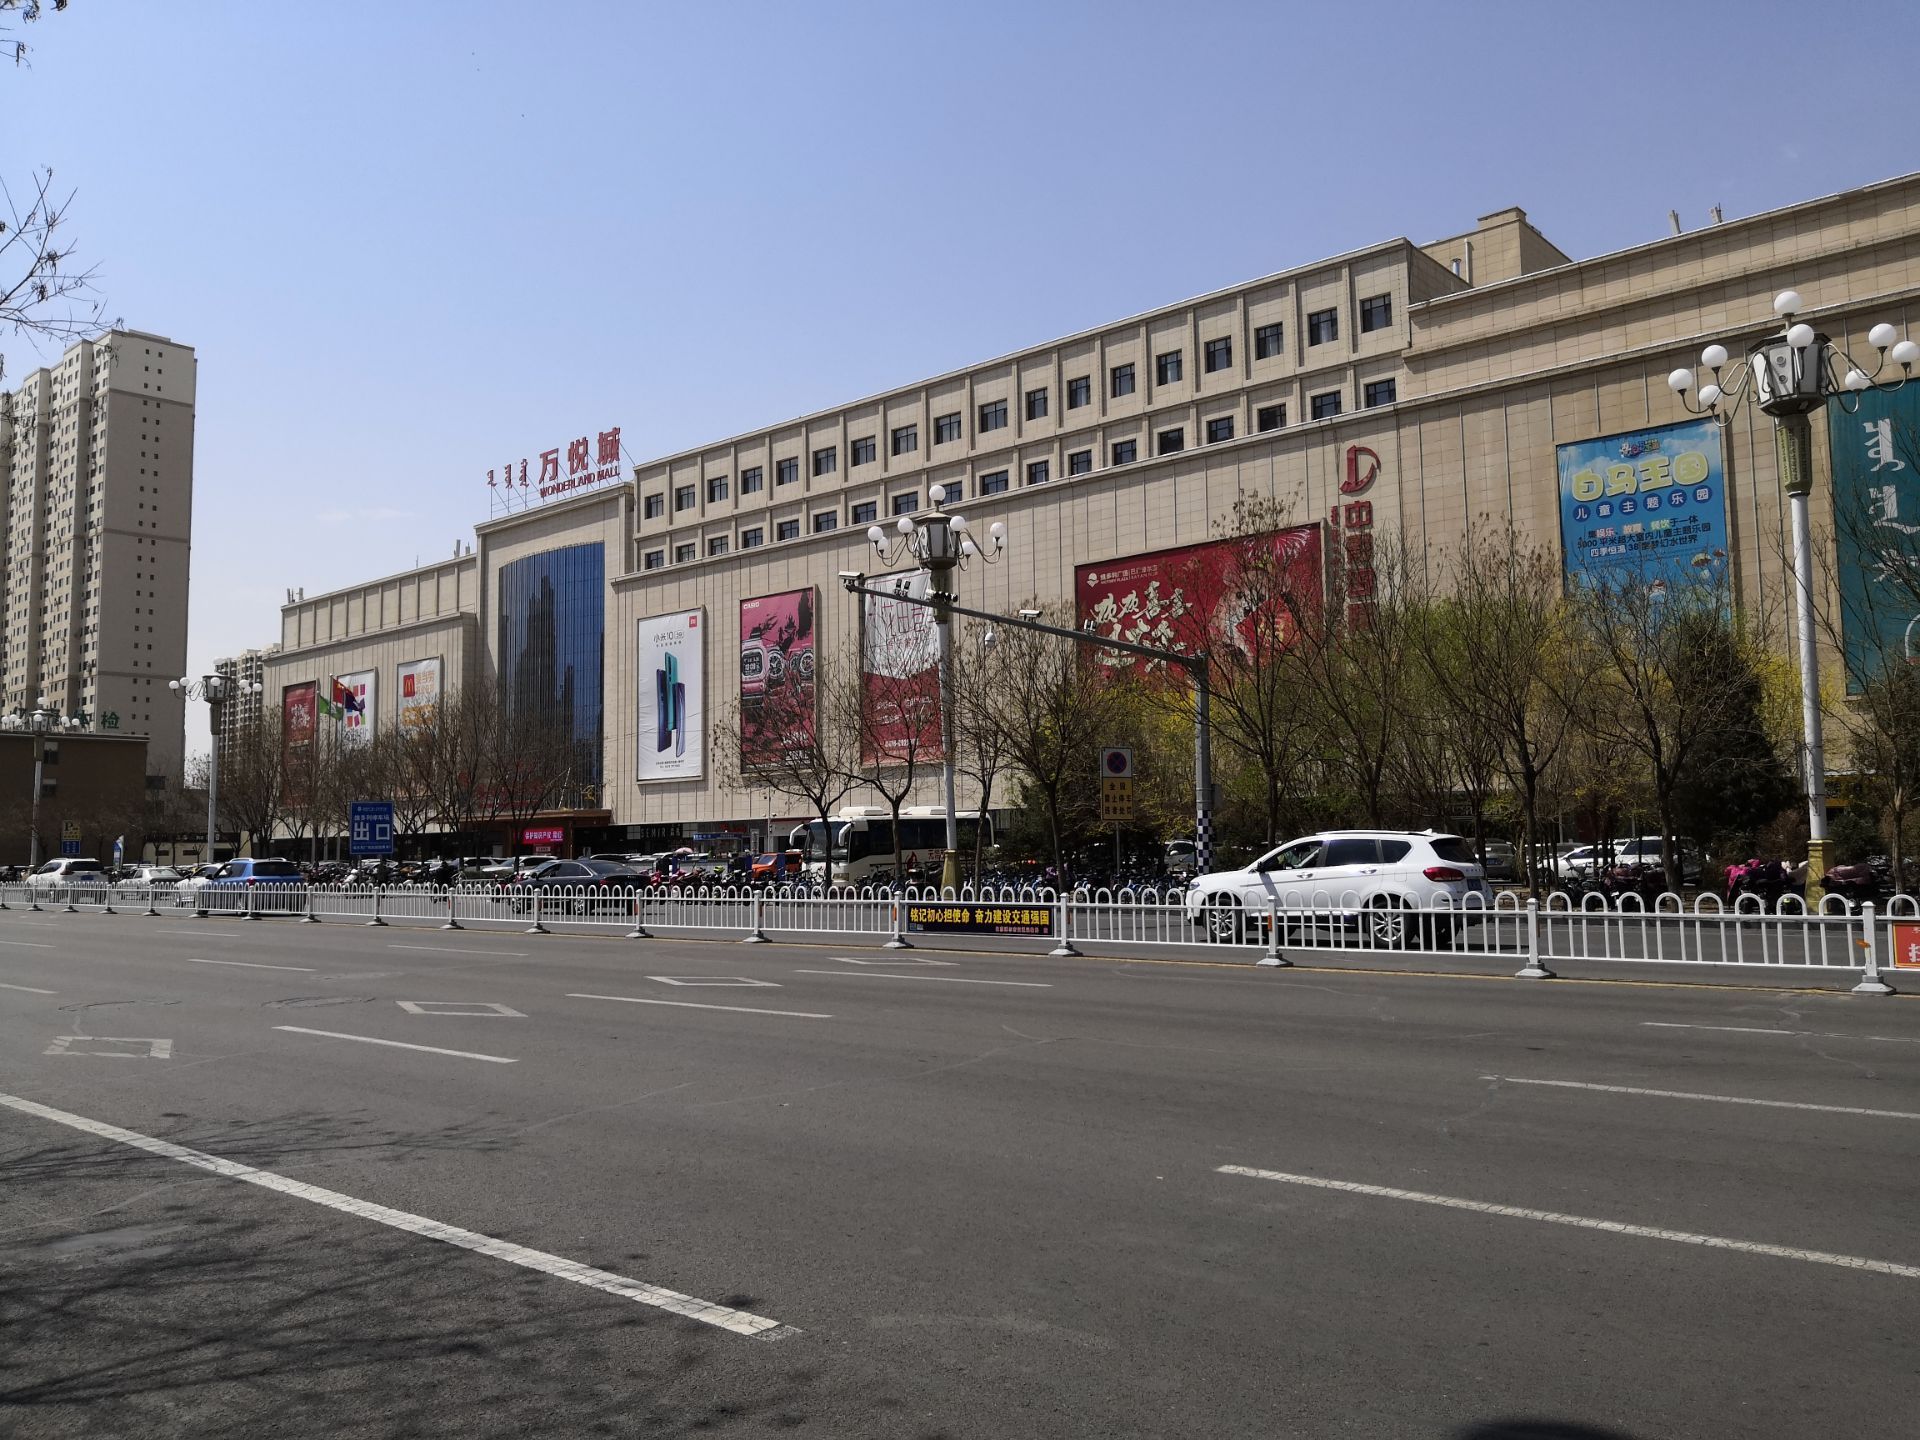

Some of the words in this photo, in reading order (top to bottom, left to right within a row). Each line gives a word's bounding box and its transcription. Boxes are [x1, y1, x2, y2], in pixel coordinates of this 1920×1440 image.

[539, 427, 621, 484] 万悦城
[540, 473, 596, 498] WONDERLAND
[597, 465, 621, 482] MALL
[1572, 451, 1709, 502] 白马王国
[1574, 487, 1710, 520] 儿童主题乐园
[353, 822, 390, 841] 出口
[910, 907, 970, 923] 铭记初心担使命
[975, 908, 1050, 925] 奋力建设交通强国
